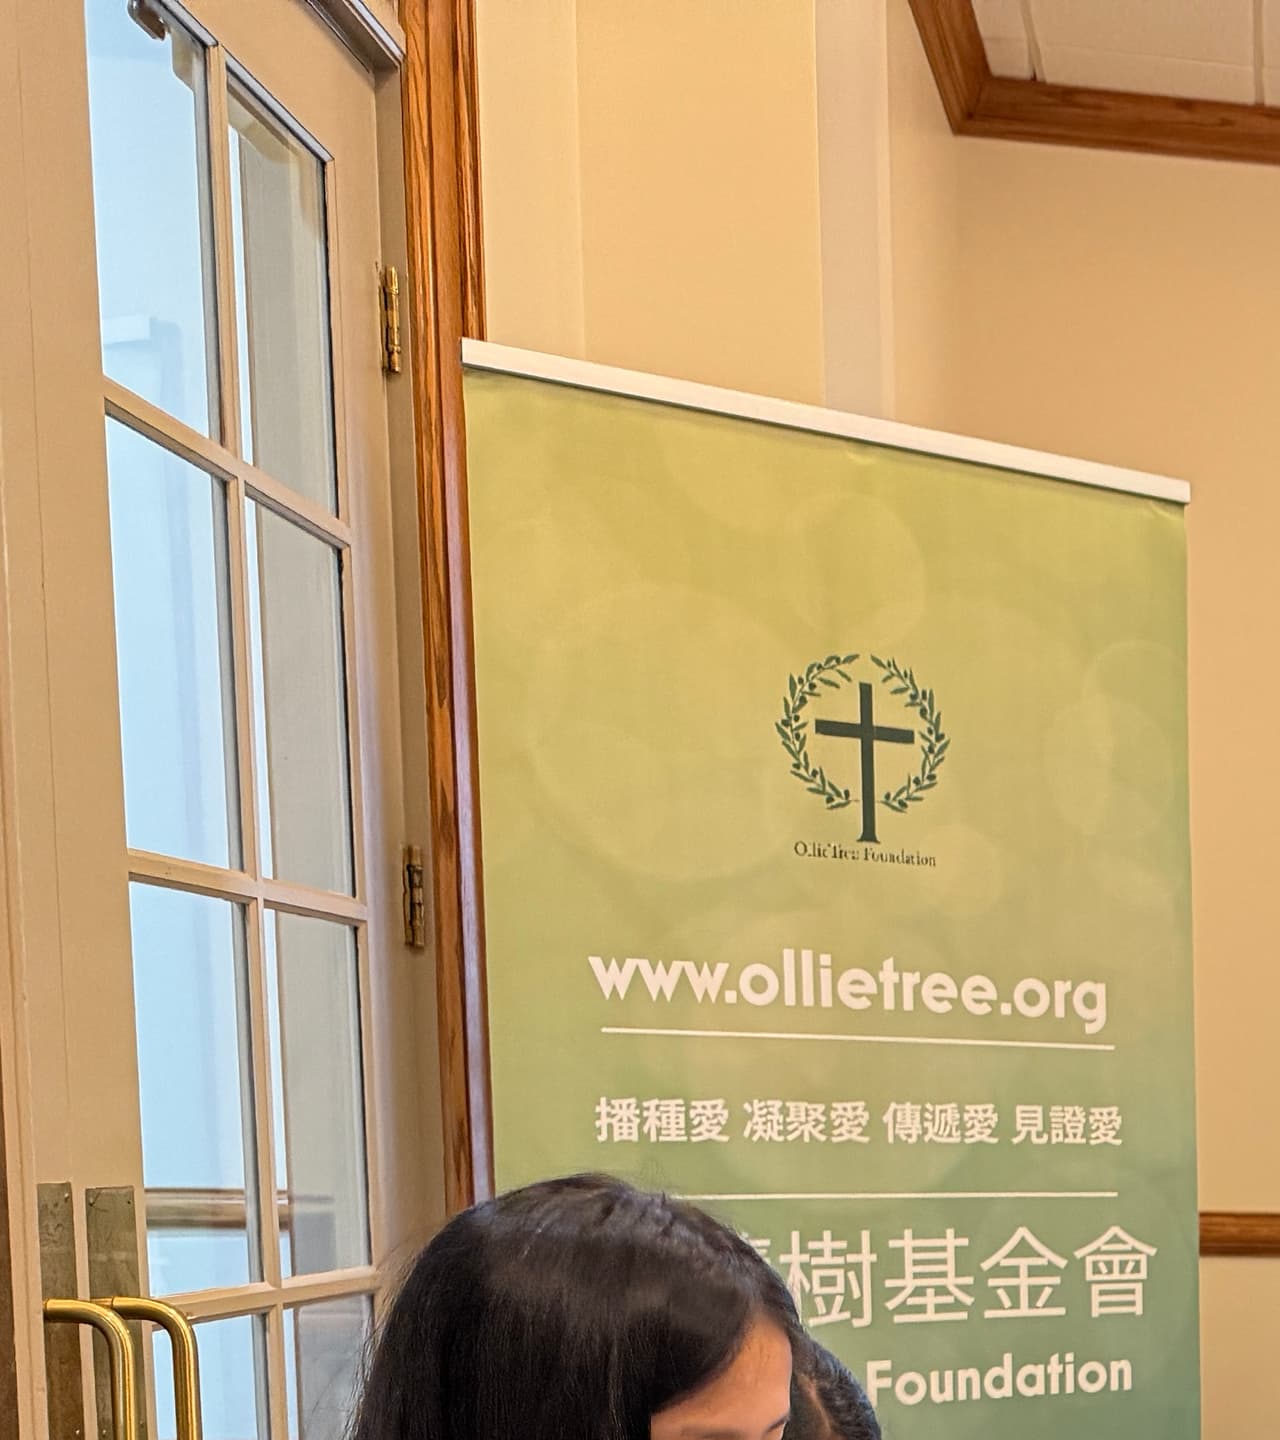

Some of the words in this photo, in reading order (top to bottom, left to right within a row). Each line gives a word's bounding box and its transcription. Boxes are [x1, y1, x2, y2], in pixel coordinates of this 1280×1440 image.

[864, 847, 936, 867] Foundation
[588, 947, 1108, 1035] www.ollietree.org
[595, 1097, 730, 1144] 播種愛
[742, 1100, 870, 1143] 凝聚愛
[882, 1101, 999, 1144] 傳遞愛
[1011, 1104, 1124, 1146] 見證愛
[743, 1226, 1158, 1329] 樹基金會
[867, 1352, 1134, 1409] Foundation
